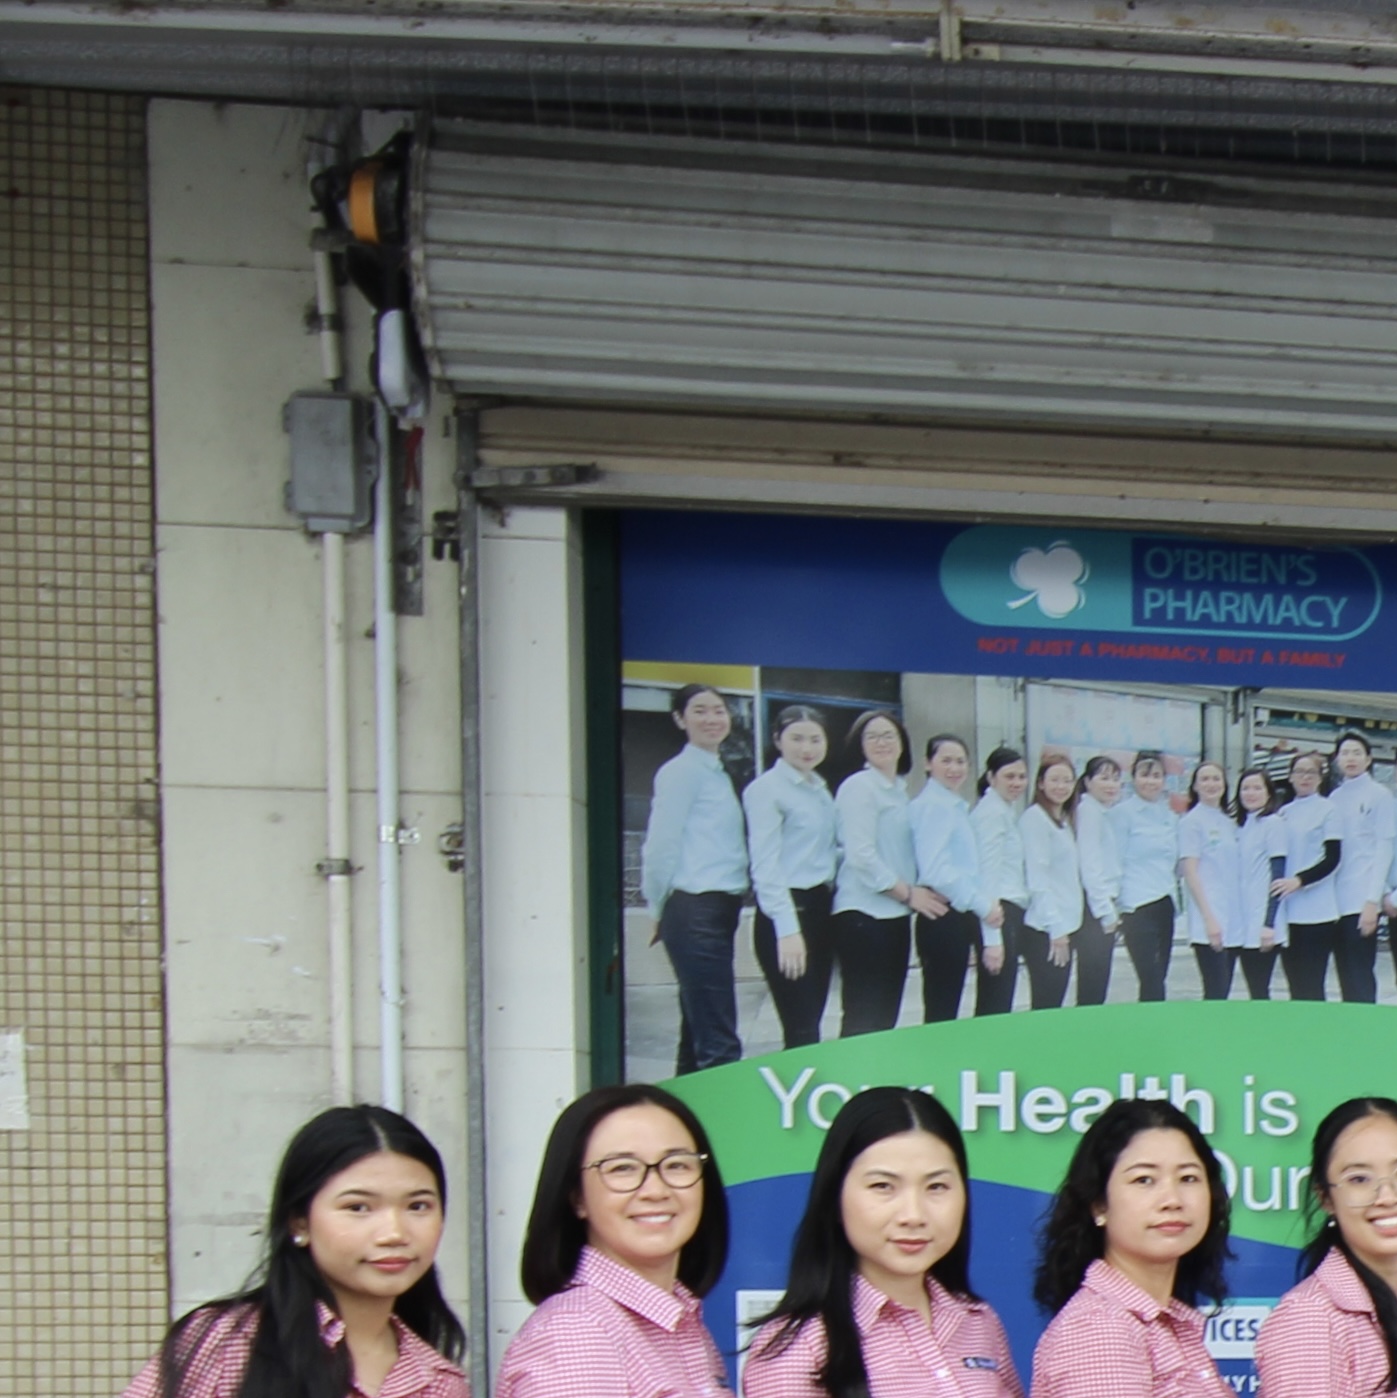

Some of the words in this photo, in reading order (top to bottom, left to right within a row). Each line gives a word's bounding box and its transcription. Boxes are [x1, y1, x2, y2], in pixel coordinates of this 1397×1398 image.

[1143, 546, 1318, 587] O'BRIEN'S
[1142, 588, 1349, 628] PHARMACY
[977, 637, 1020, 655] NOT
[1025, 639, 1076, 657] JUST
[1079, 642, 1093, 657] A
[1216, 648, 1254, 666] BUT
[1260, 650, 1275, 666] A
[1278, 651, 1346, 669] FAMILY
[759, 1066, 935, 1130] Yo
[1243, 1075, 1299, 1137] is
